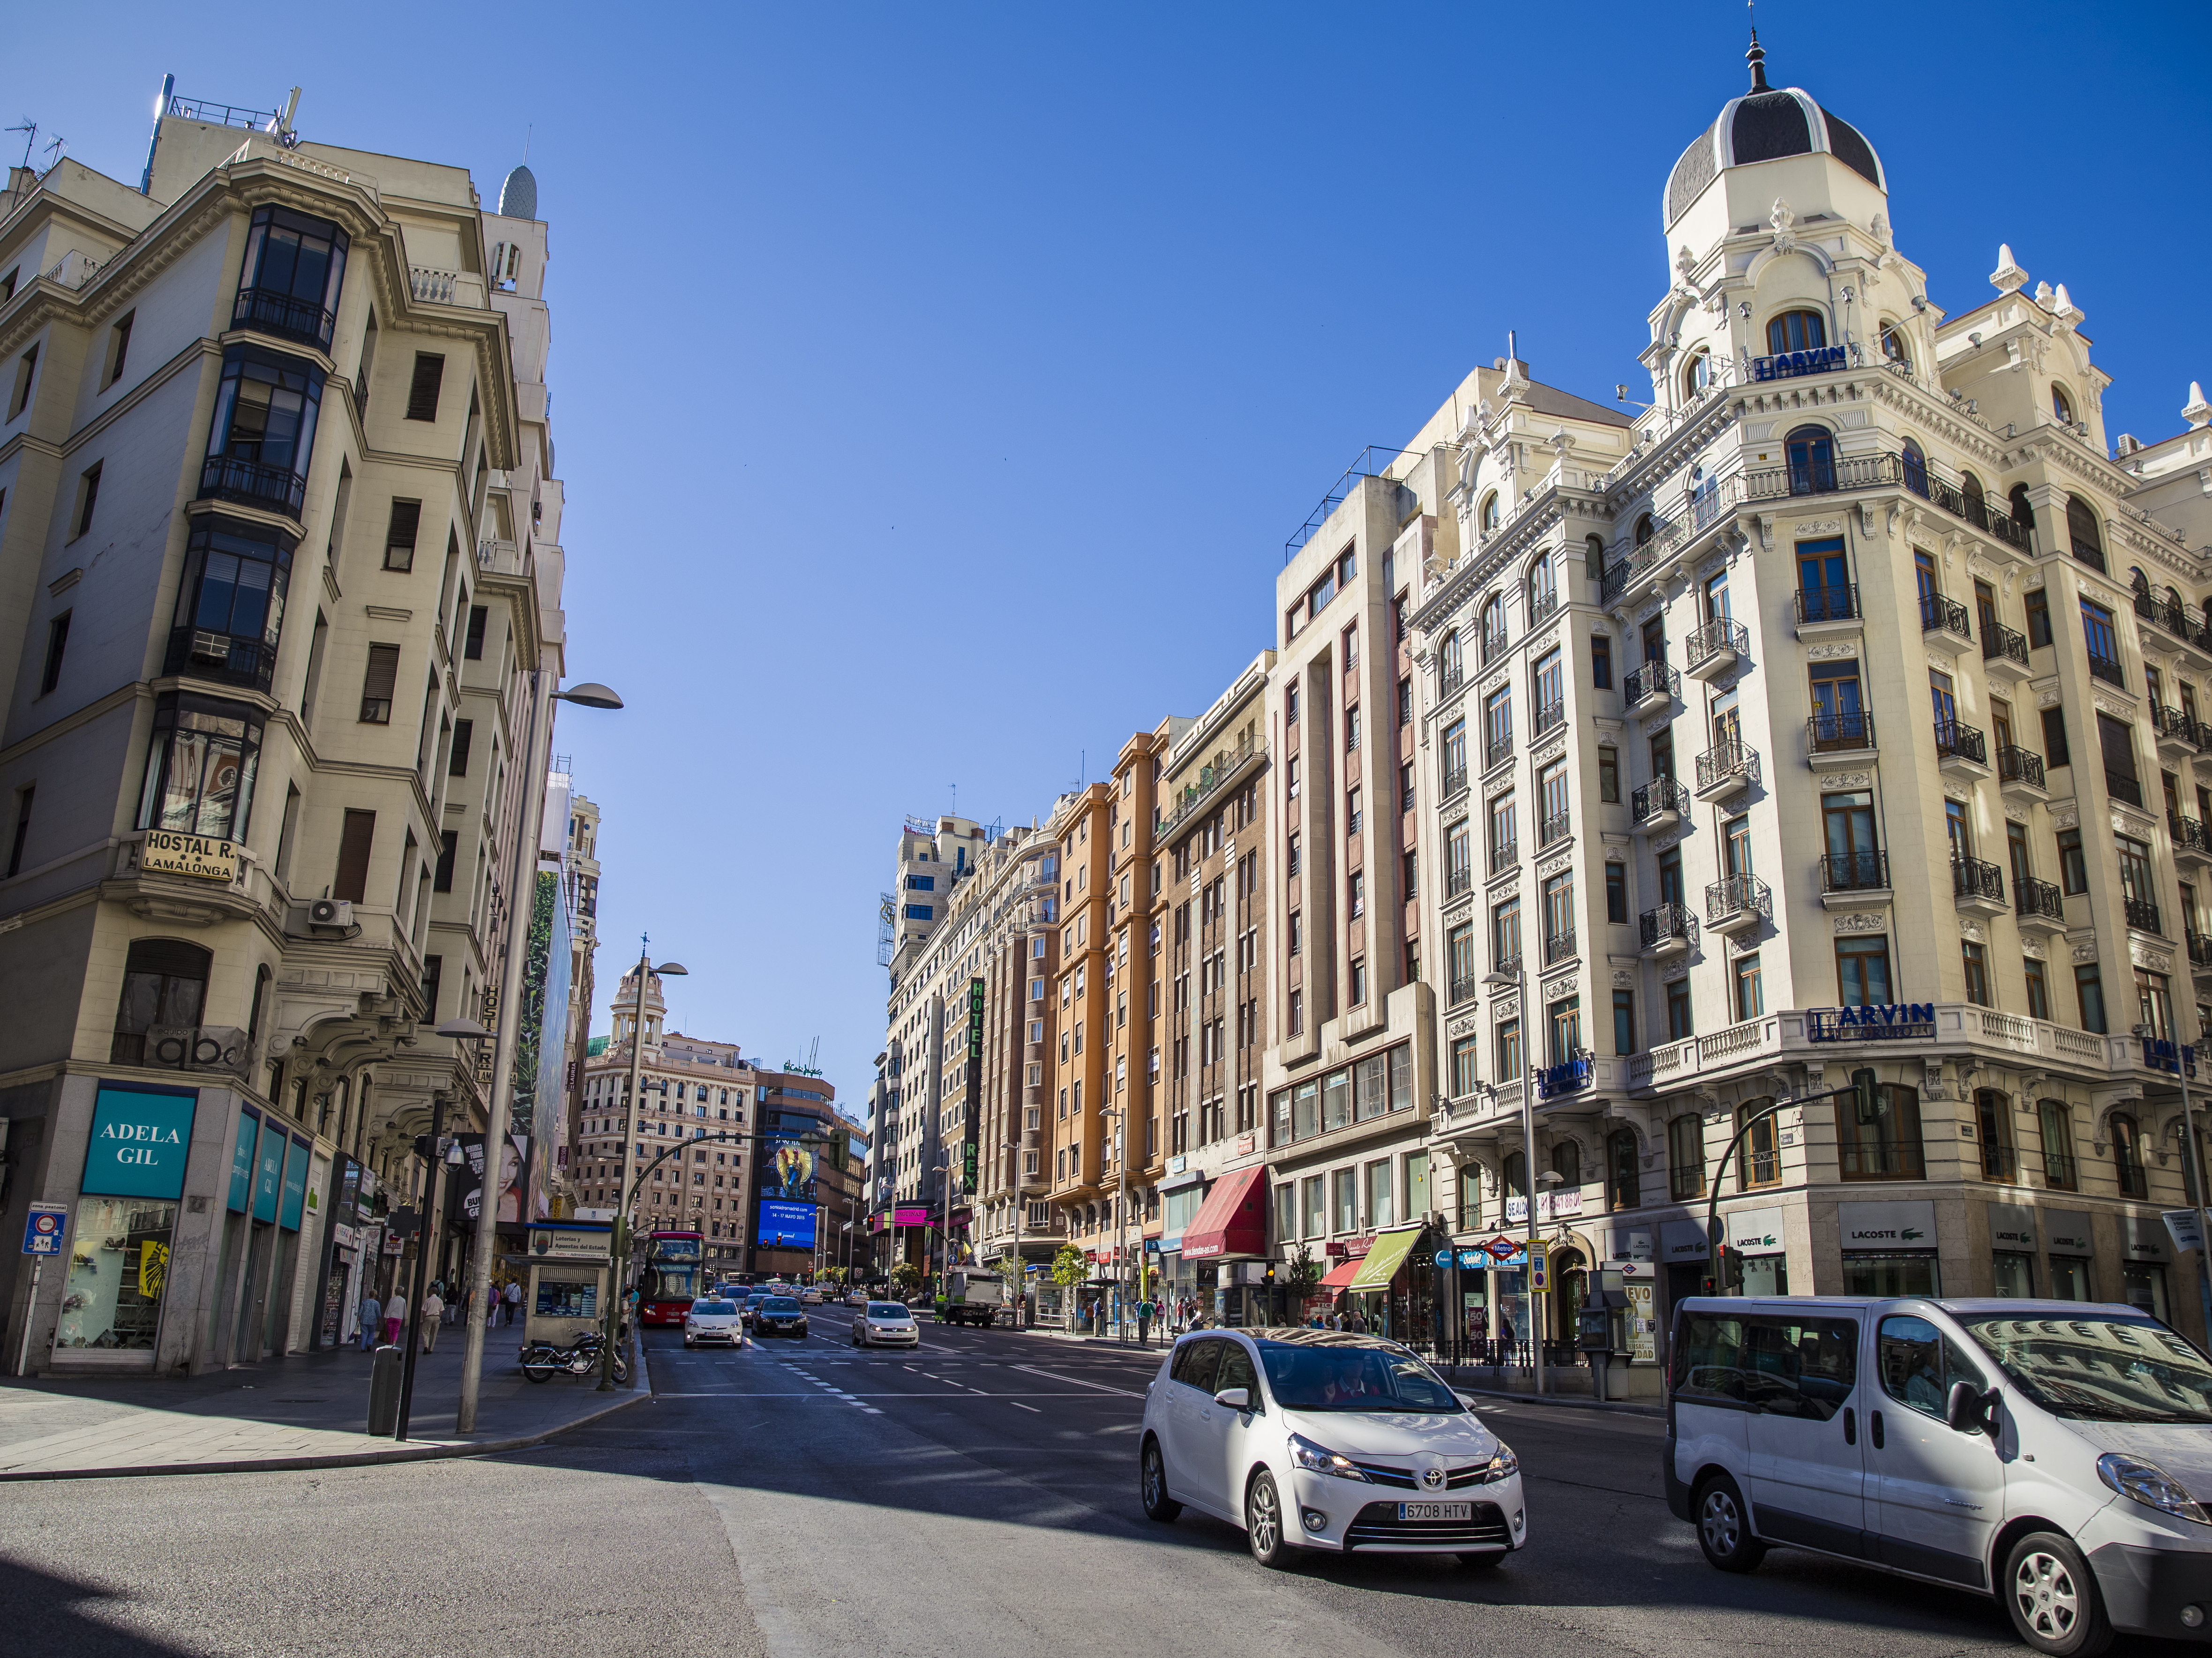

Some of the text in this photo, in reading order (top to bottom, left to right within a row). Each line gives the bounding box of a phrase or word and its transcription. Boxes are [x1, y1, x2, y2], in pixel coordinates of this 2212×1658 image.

[147, 832, 235, 859] HOSTAL R.
[145, 857, 231, 877] LAMALONGA
[971, 983, 982, 1057] HOTEL
[1861, 1026, 1912, 1038] GRUPO
[99, 1123, 180, 1143] ADELA
[117, 1148, 159, 1165] GIL
[264, 1158, 277, 1175] ADELA
[964, 1143, 976, 1189] REX
[1508, 1202, 1515, 1217] SE
[1541, 1196, 1548, 1211] 91
[1550, 1195, 1564, 1210] 541
[1852, 1231, 1897, 1239] LACOSTE
[1996, 1232, 2018, 1241] LACOSTE
[1737, 1238, 1762, 1247] LACOSTE
[2054, 1237, 2074, 1246] LACOSTE
[2131, 1243, 2150, 1252] LACOSTE
[1184, 1244, 1219, 1256] www.tiendas-asi.com
[1944, 1498, 1984, 1510] Passenger
[1407, 1505, 1440, 1517] 6708
[1444, 1505, 1467, 1517] HTV
